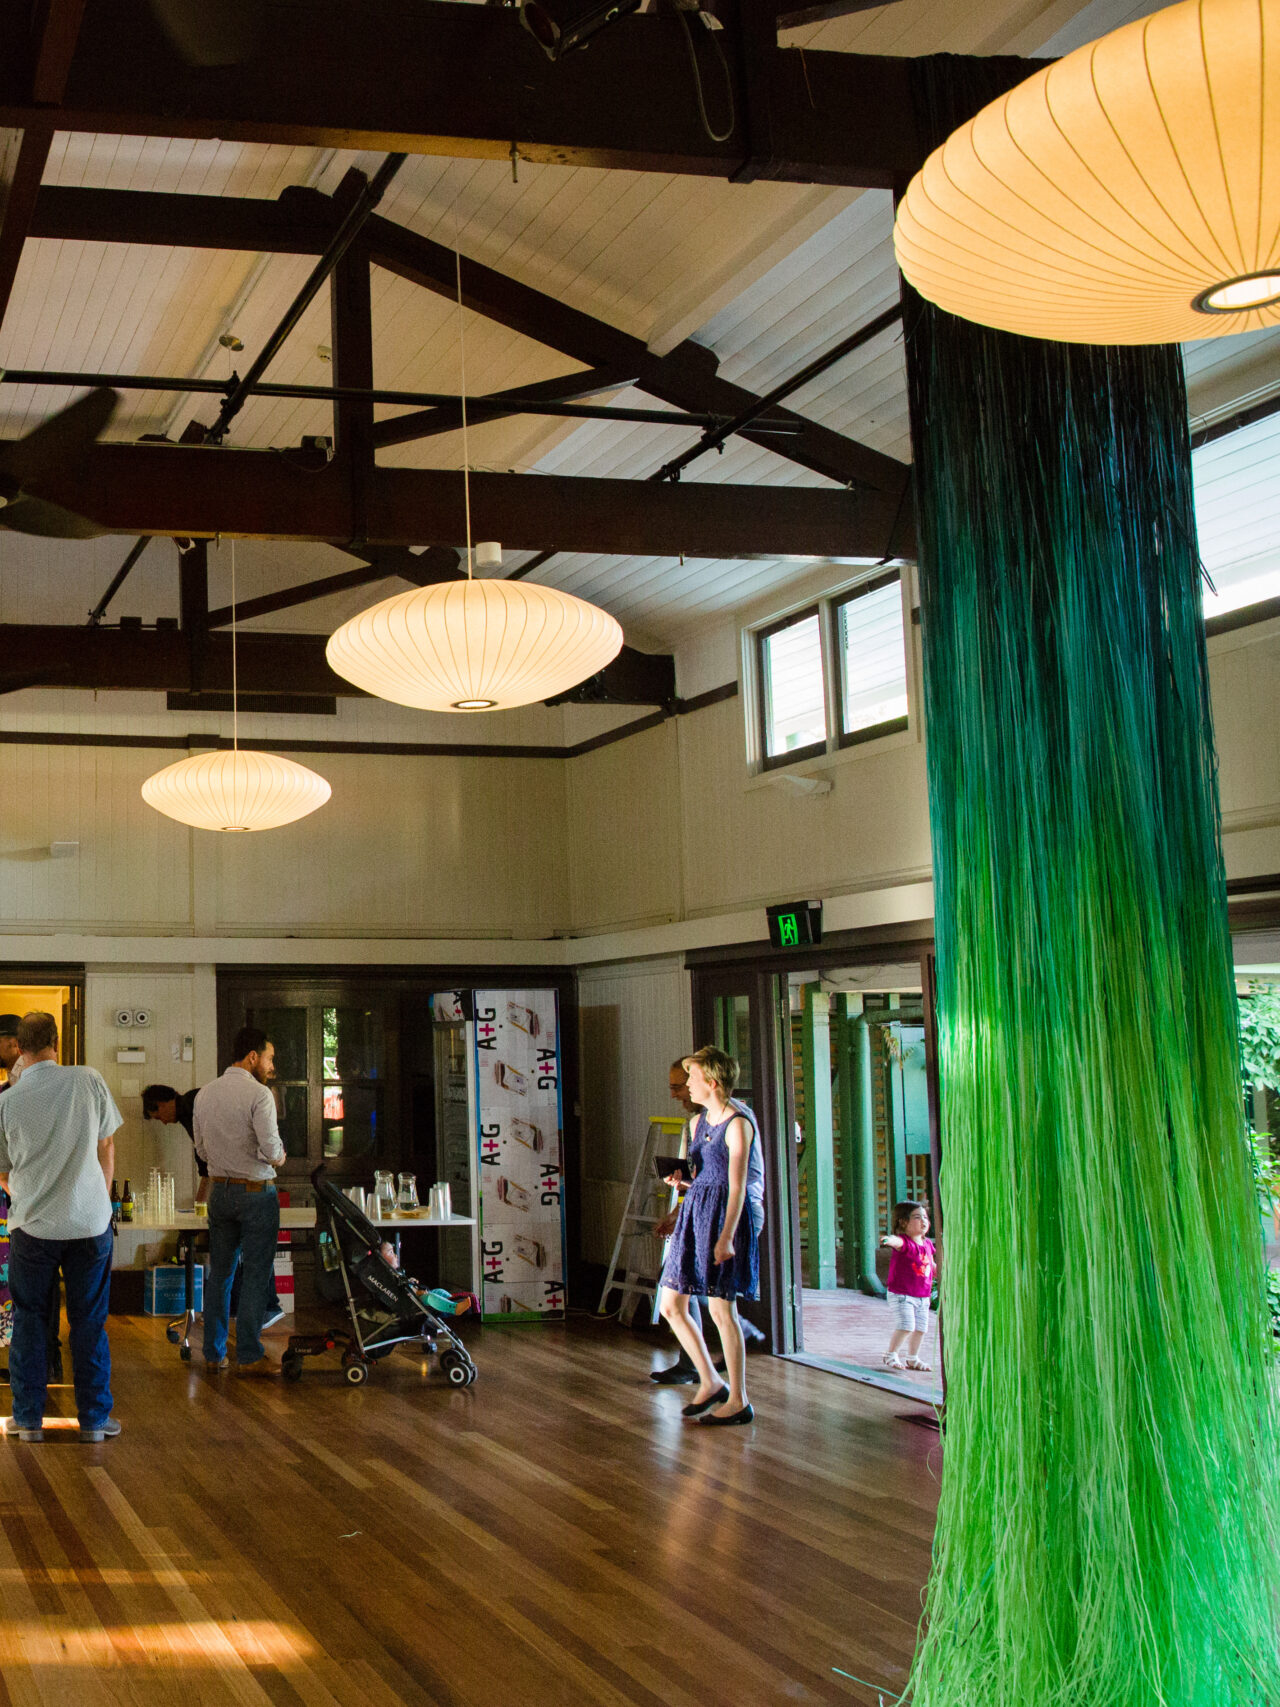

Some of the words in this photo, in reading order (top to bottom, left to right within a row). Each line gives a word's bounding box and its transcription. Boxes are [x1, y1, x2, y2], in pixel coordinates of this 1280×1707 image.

[477, 1007, 497, 1050] A+G
[536, 1048, 557, 1090] A+G
[480, 1123, 501, 1166] A+G
[540, 1163, 561, 1206] A+G
[482, 1241, 504, 1284] A+G
[367, 1274, 399, 1303] MACLAREN
